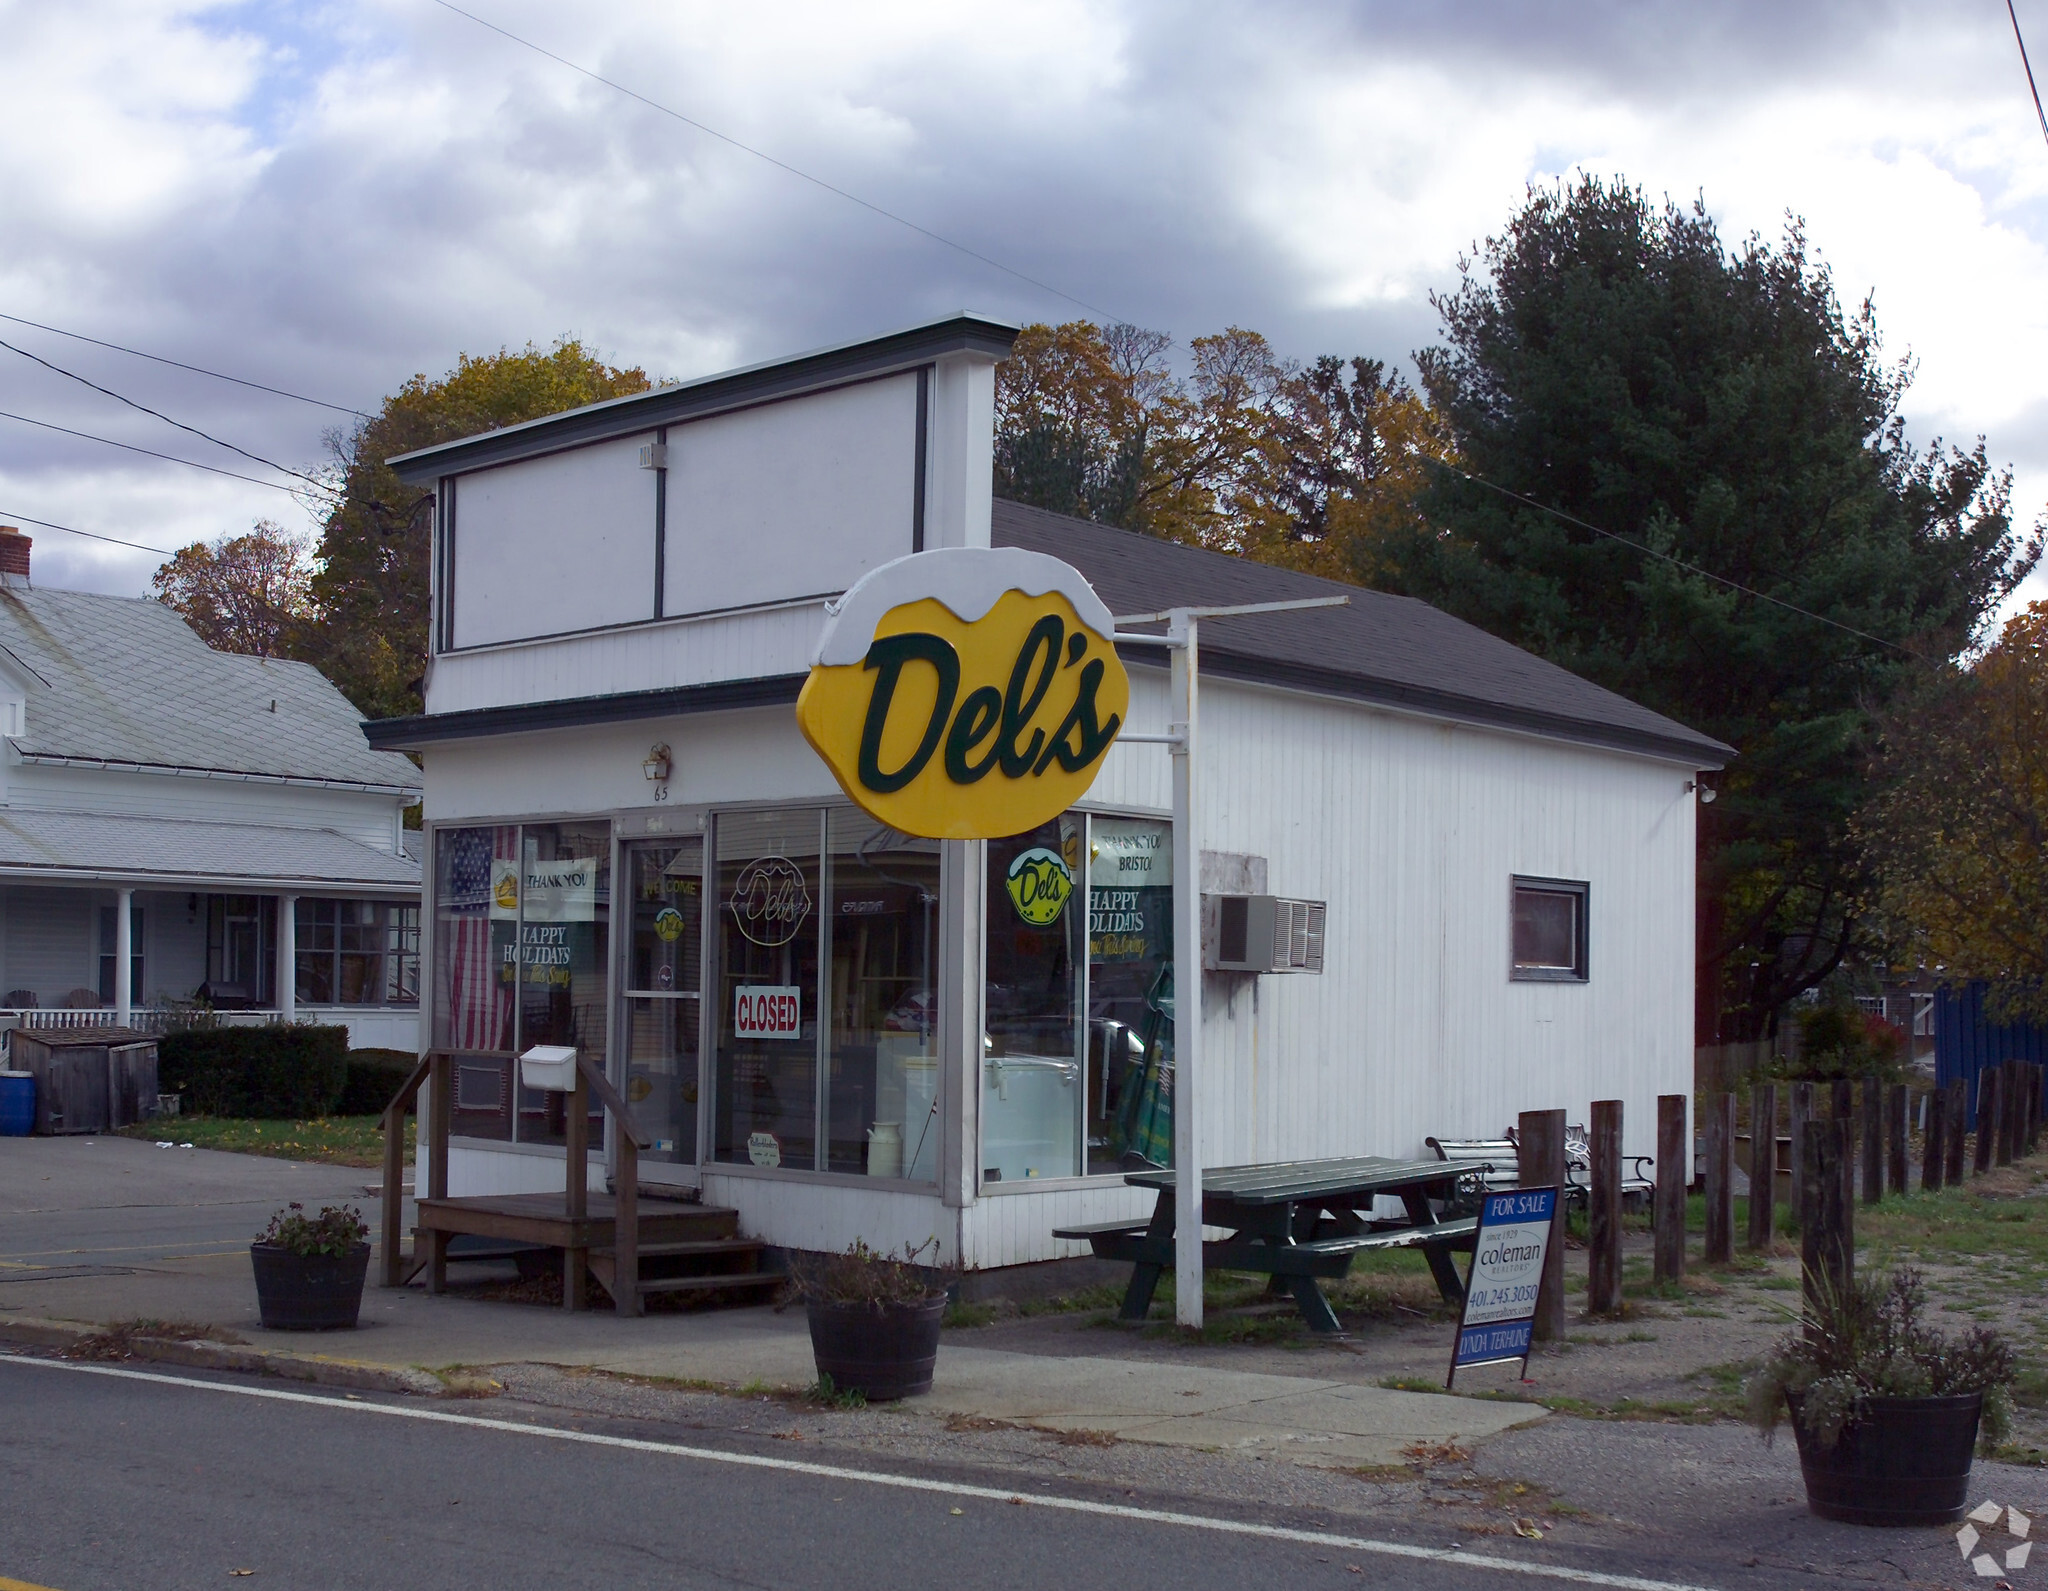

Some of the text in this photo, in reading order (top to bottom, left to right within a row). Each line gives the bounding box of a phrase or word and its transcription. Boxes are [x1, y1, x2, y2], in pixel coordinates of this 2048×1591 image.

[859, 614, 1120, 793] Del's
[654, 786, 668, 801] 65
[1102, 835, 1142, 849] THANK
[528, 875, 562, 888] THANK
[563, 873, 588, 886] YOU
[644, 879, 696, 898] WELCOME
[1019, 866, 1062, 907] Del's
[746, 874, 795, 923] Del's
[1090, 891, 1139, 911] HAPPY
[658, 917, 682, 935] Del's
[1090, 912, 1144, 933] OLIDAYS
[738, 994, 798, 1032] CLOSED
[1492, 1195, 1546, 1216] FOR SALE
[1486, 1233, 1502, 1242] since
[1481, 1242, 1541, 1265] coleman
[1491, 1263, 1529, 1274] REALTORS
[1469, 1285, 1538, 1308] 401.245.3050
[1467, 1307, 1532, 1322] colemanrealtors.com
[1459, 1328, 1530, 1355] LYNDA TERHUNE
